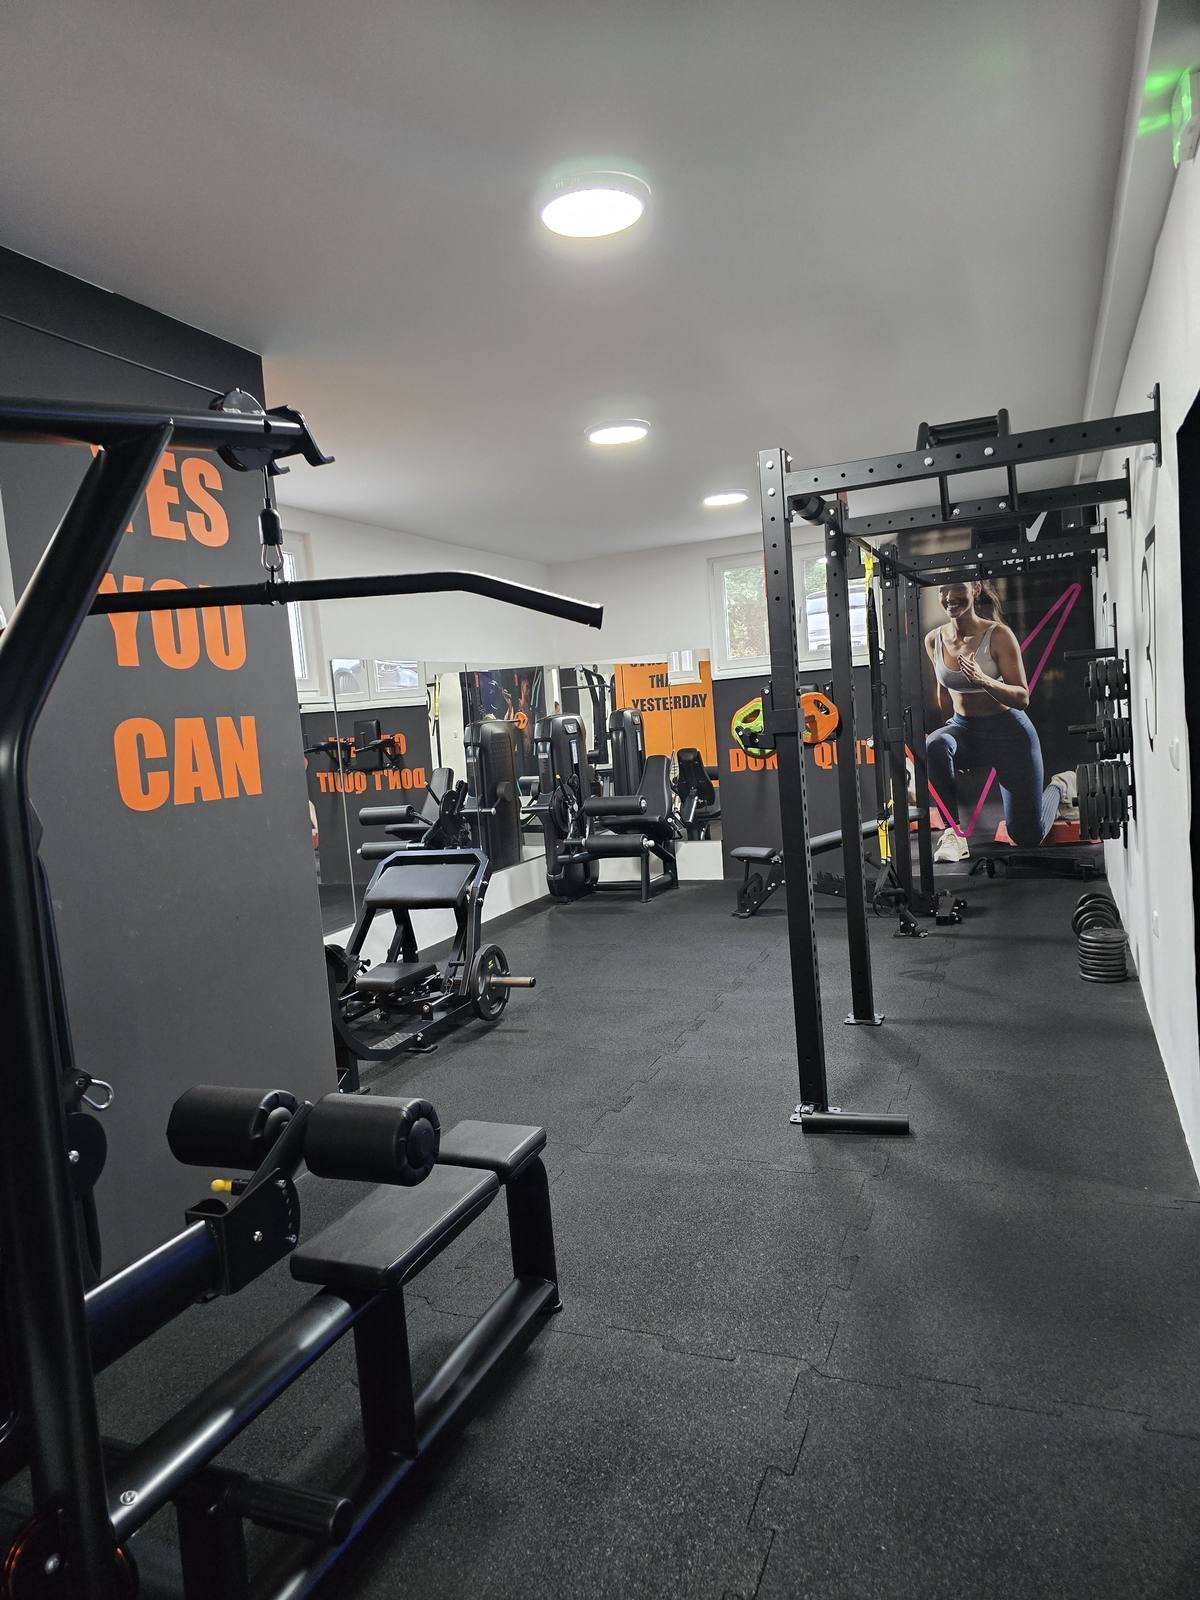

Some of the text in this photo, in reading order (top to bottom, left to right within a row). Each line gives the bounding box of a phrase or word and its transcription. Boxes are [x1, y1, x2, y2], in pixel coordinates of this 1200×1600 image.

[90, 445, 230, 548] ES
[97, 572, 247, 671] YOU
[631, 693, 707, 712] YESTERDAY
[113, 715, 263, 812] CAN
